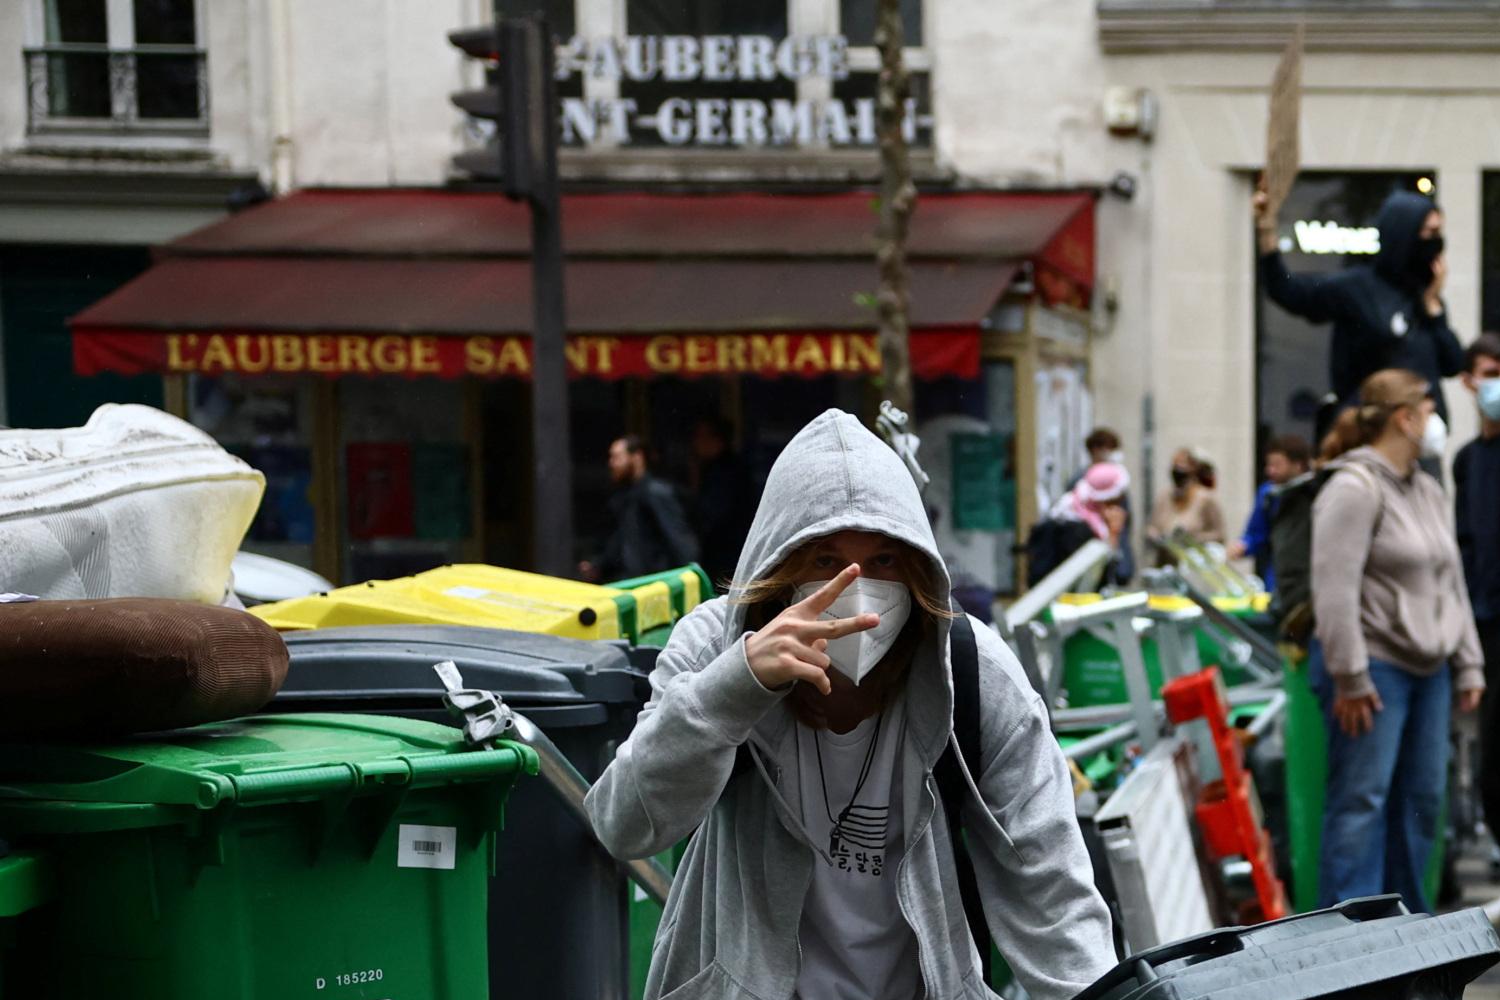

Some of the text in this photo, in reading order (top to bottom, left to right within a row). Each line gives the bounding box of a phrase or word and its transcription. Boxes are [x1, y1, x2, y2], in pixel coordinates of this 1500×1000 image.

[166, 334, 883, 373] L'AUBERGE SANT GERMAIN
[316, 968, 383, 990] D 185220
